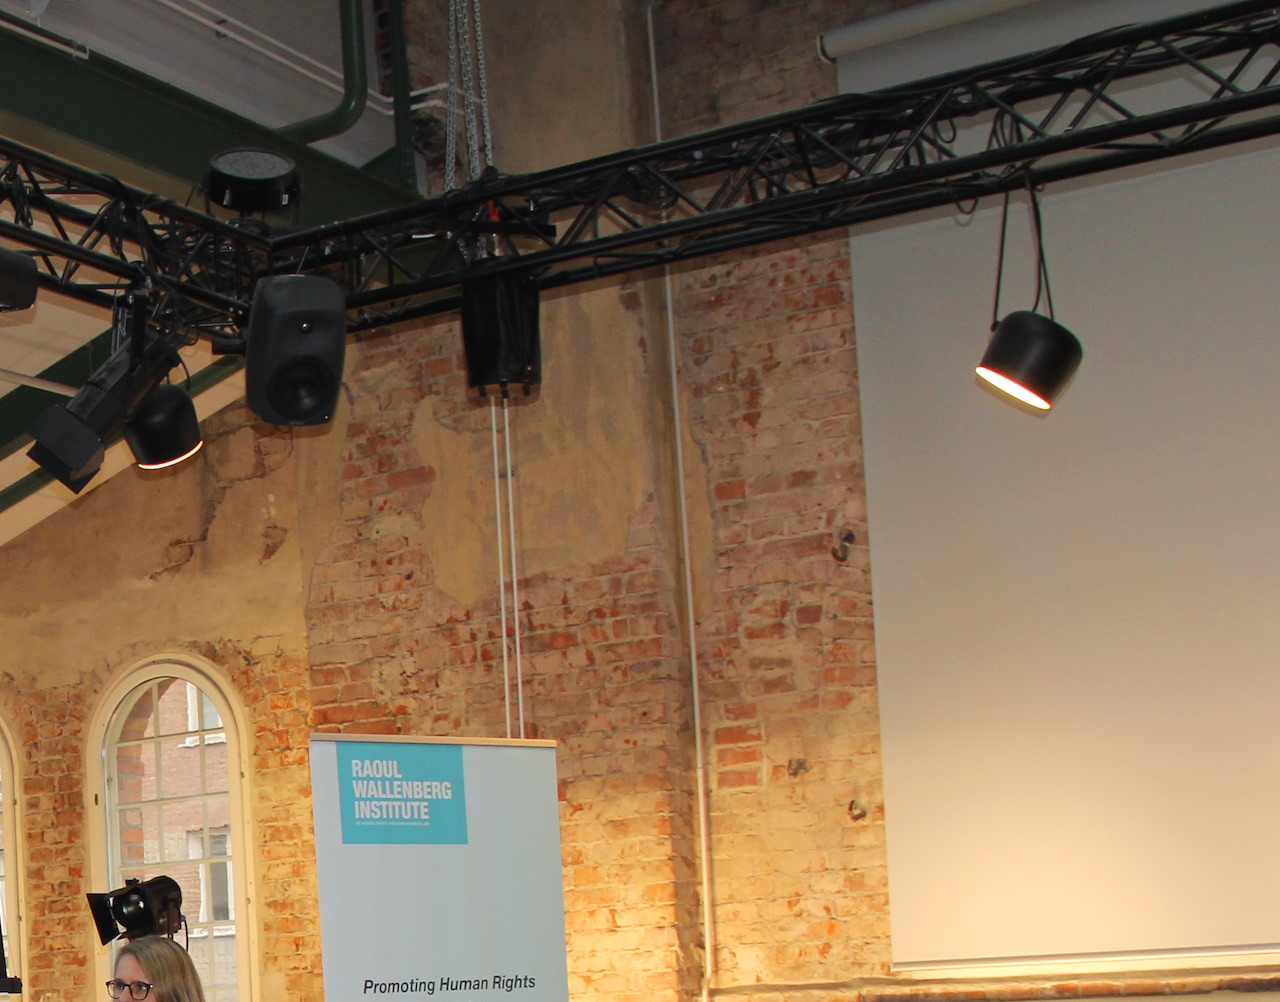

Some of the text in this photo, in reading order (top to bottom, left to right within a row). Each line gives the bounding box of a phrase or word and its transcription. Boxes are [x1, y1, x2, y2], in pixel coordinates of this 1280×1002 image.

[351, 760, 402, 779] RAOUL
[352, 780, 452, 800] WALLENBERG
[354, 801, 429, 820] INSTITUTE
[363, 974, 536, 995] Promoting Human Rights
